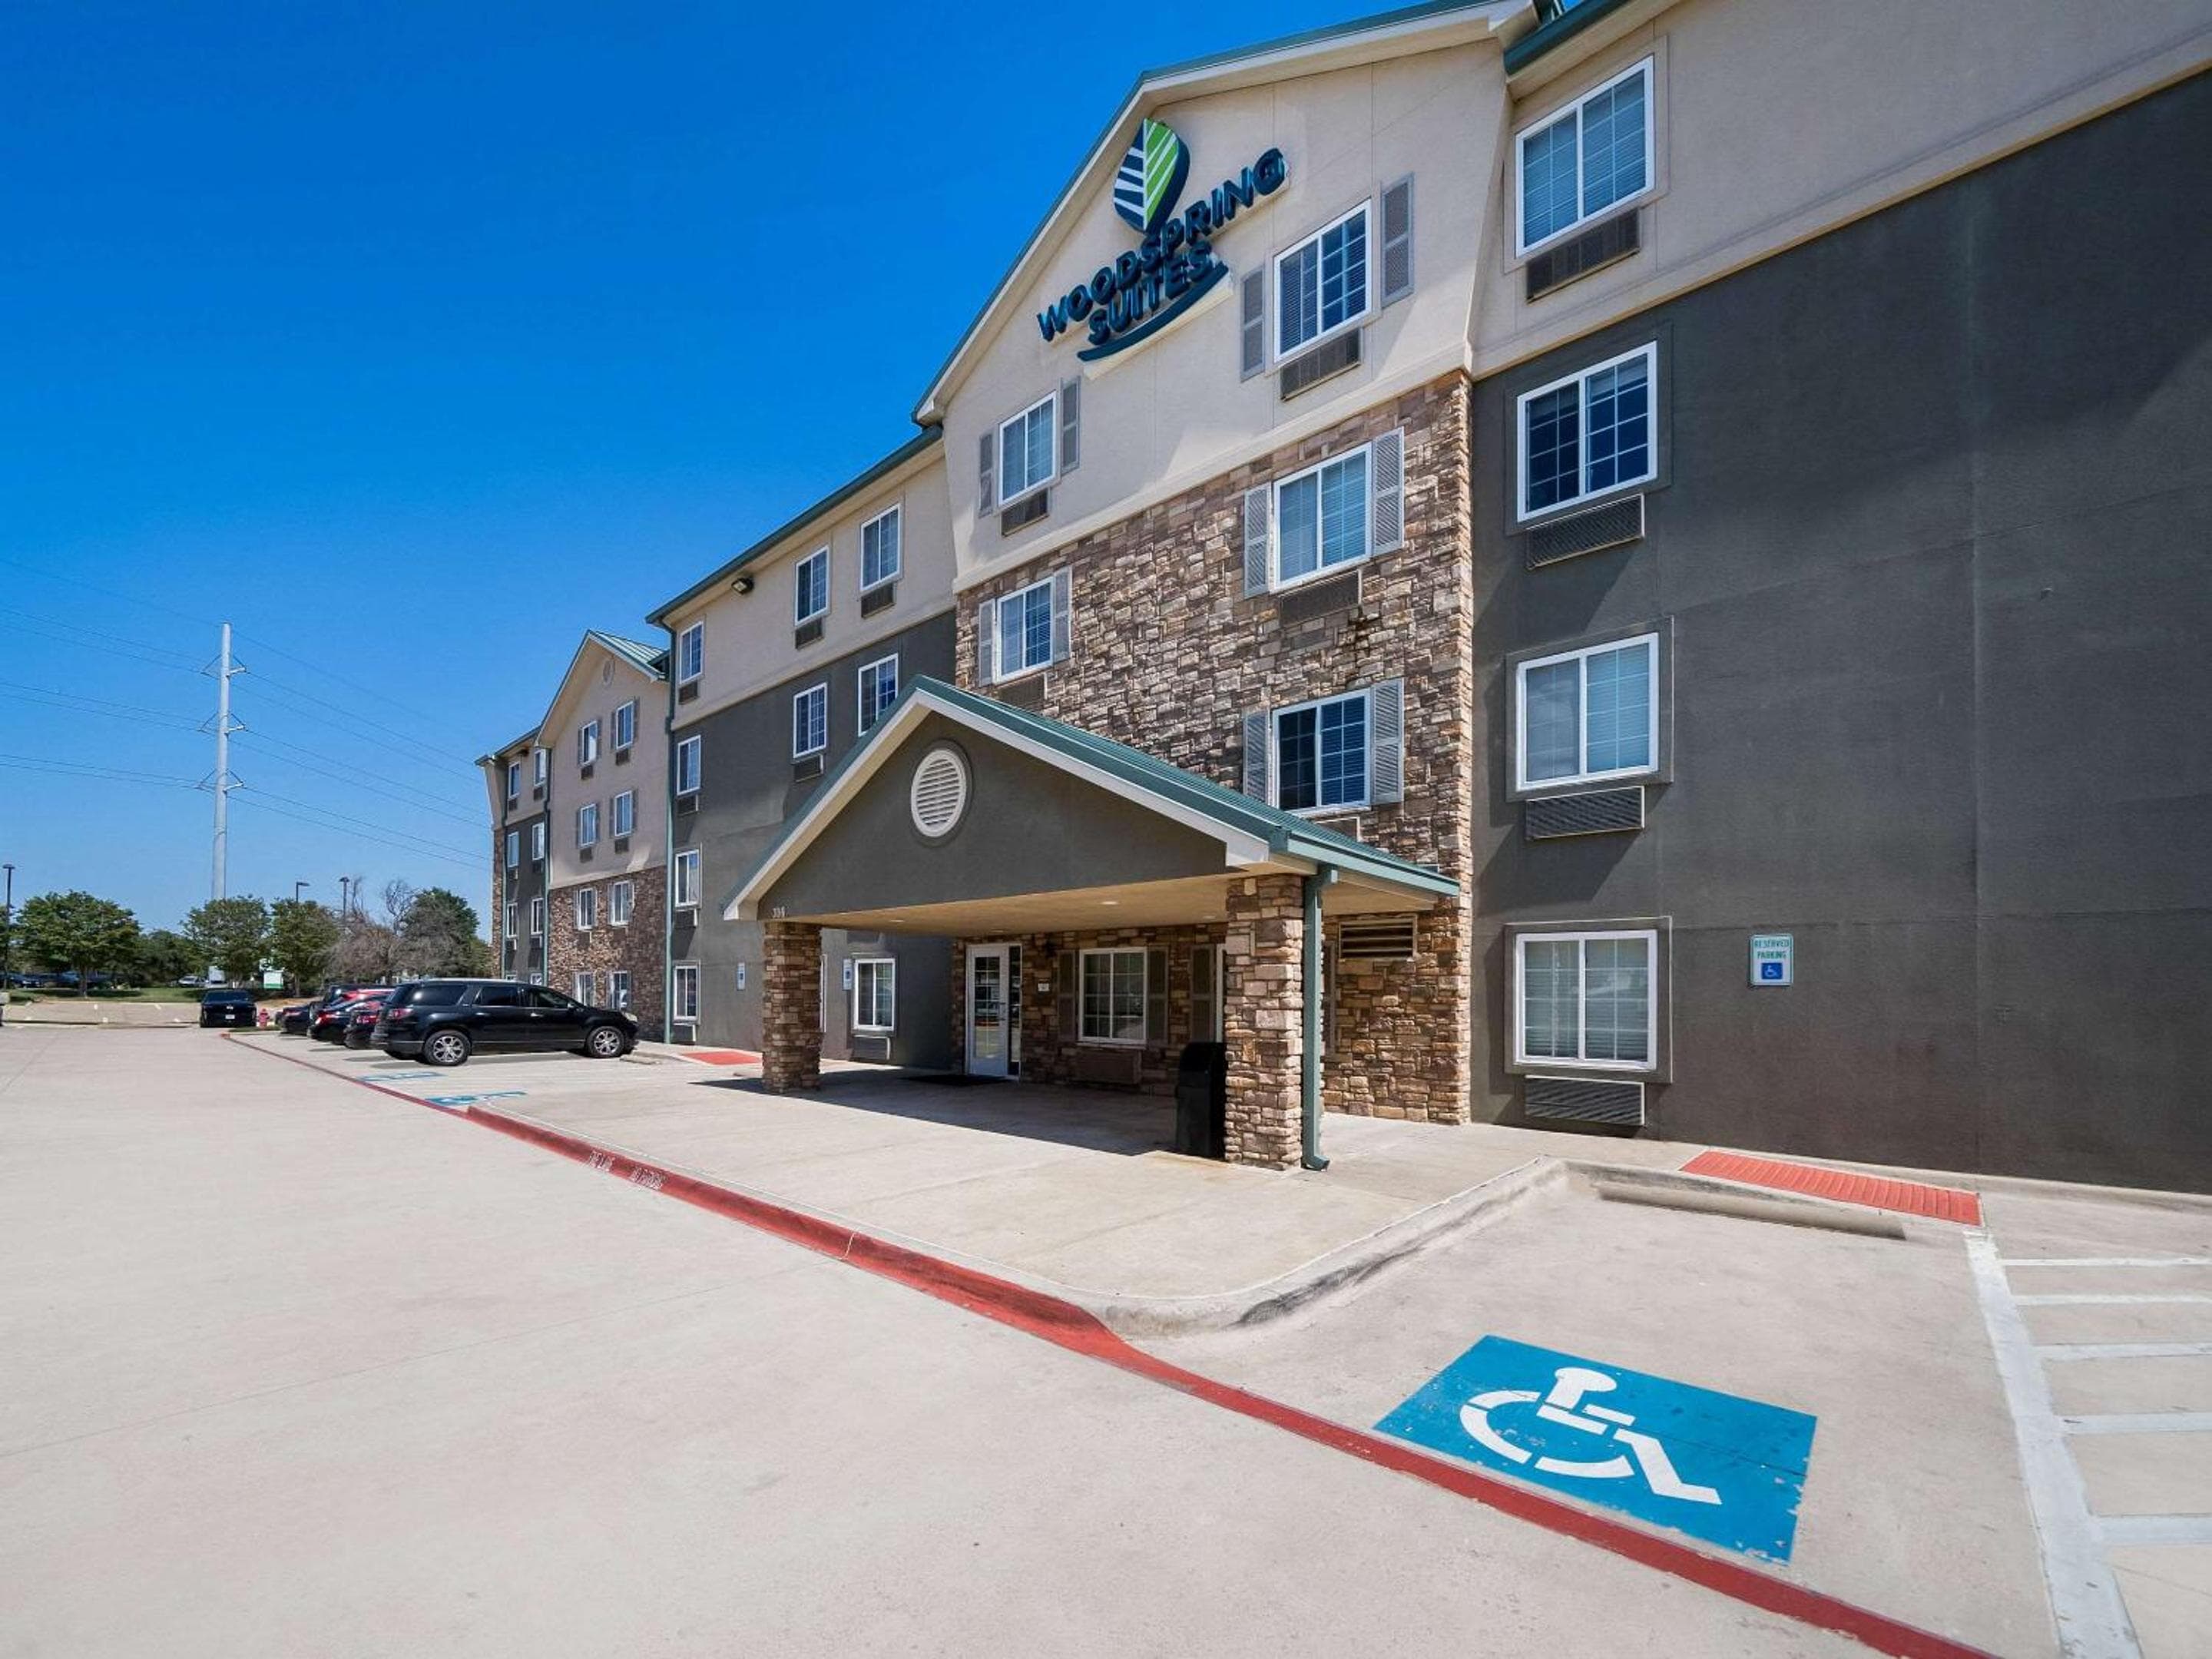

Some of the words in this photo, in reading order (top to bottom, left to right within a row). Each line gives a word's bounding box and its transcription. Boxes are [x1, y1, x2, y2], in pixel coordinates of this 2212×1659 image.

[1036, 147, 1287, 343] WOODSPRING
[1088, 240, 1217, 346] SUITES
[1754, 939, 1790, 948] RESERVED
[1757, 951, 1787, 959] PARKING
